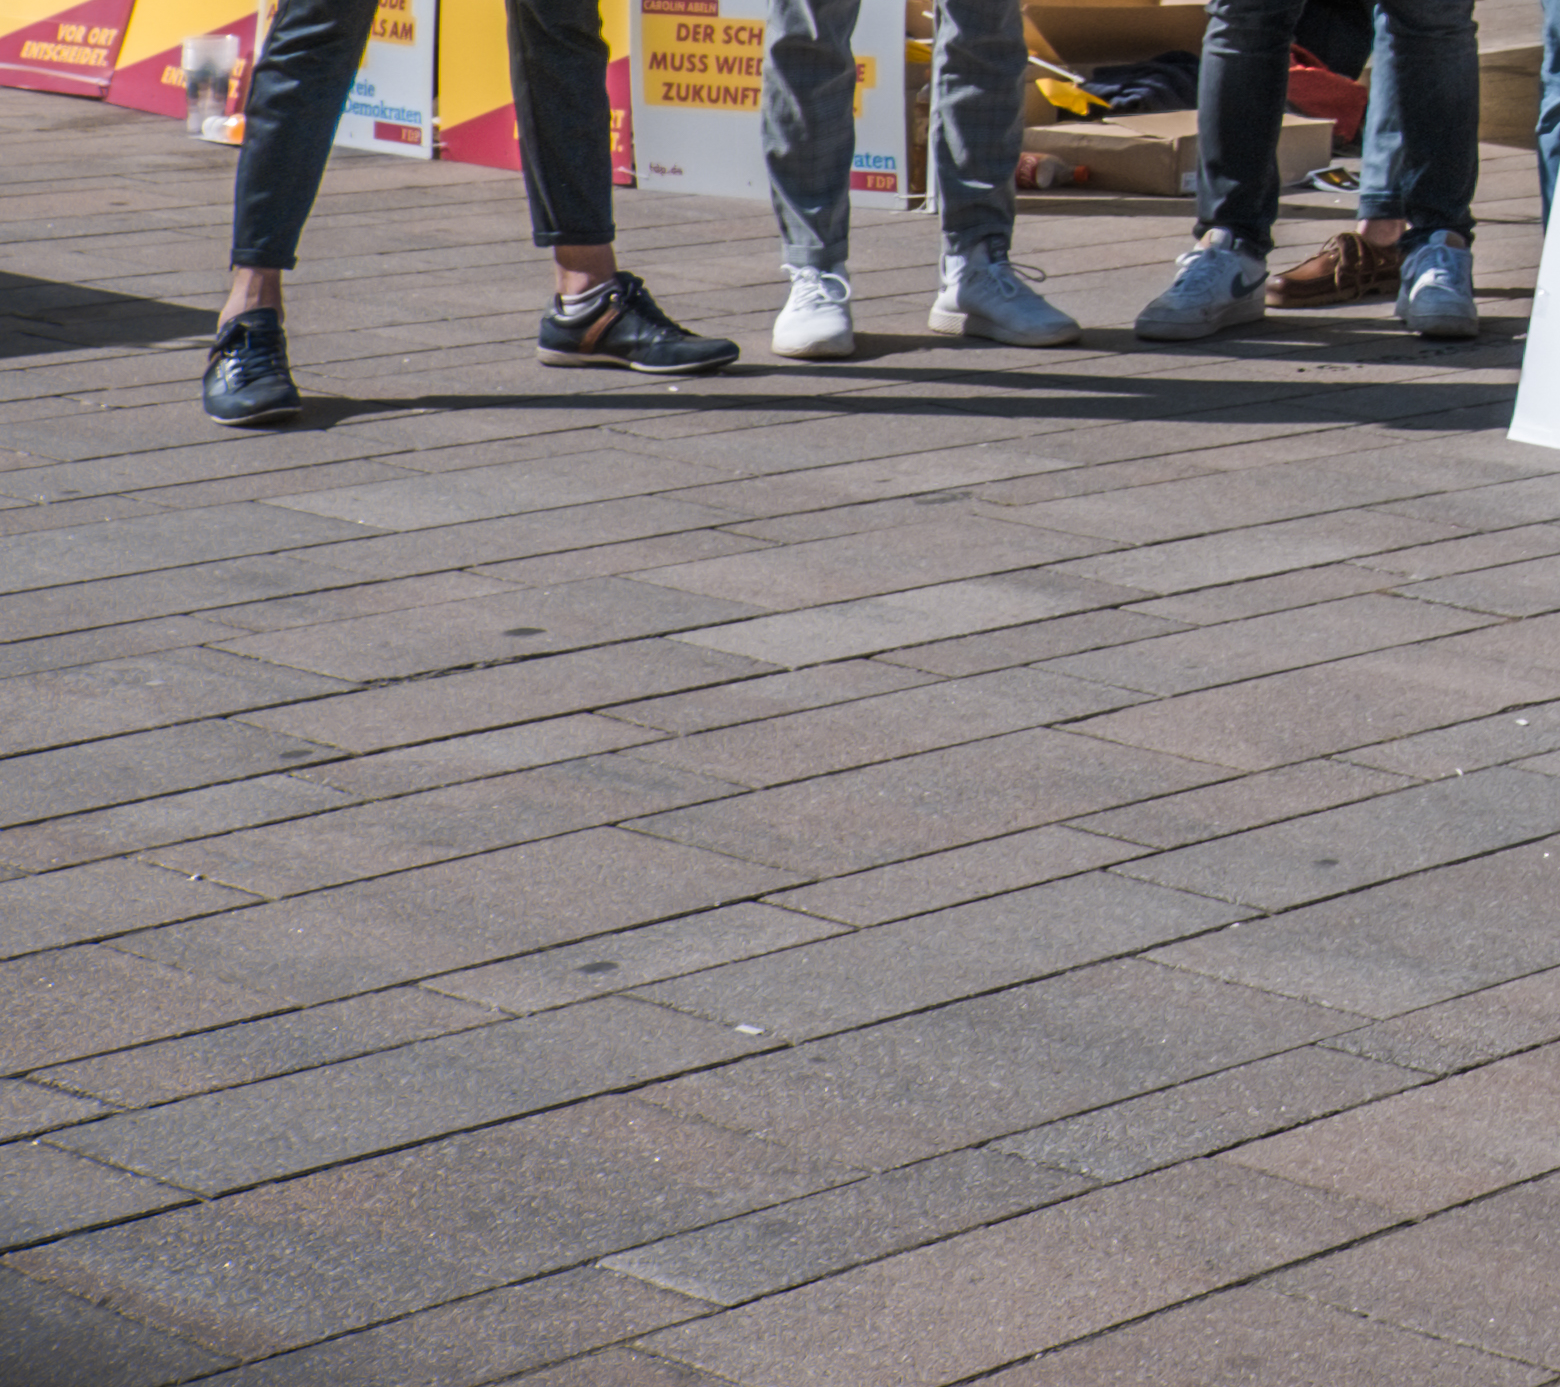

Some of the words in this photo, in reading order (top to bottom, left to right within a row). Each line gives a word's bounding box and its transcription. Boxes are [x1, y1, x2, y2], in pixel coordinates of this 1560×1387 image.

[58, 24, 86, 42] VOR
[676, 22, 716, 44] DER
[722, 24, 764, 47] SCH
[649, 52, 709, 75] MUSS
[867, 176, 896, 190] FDP
